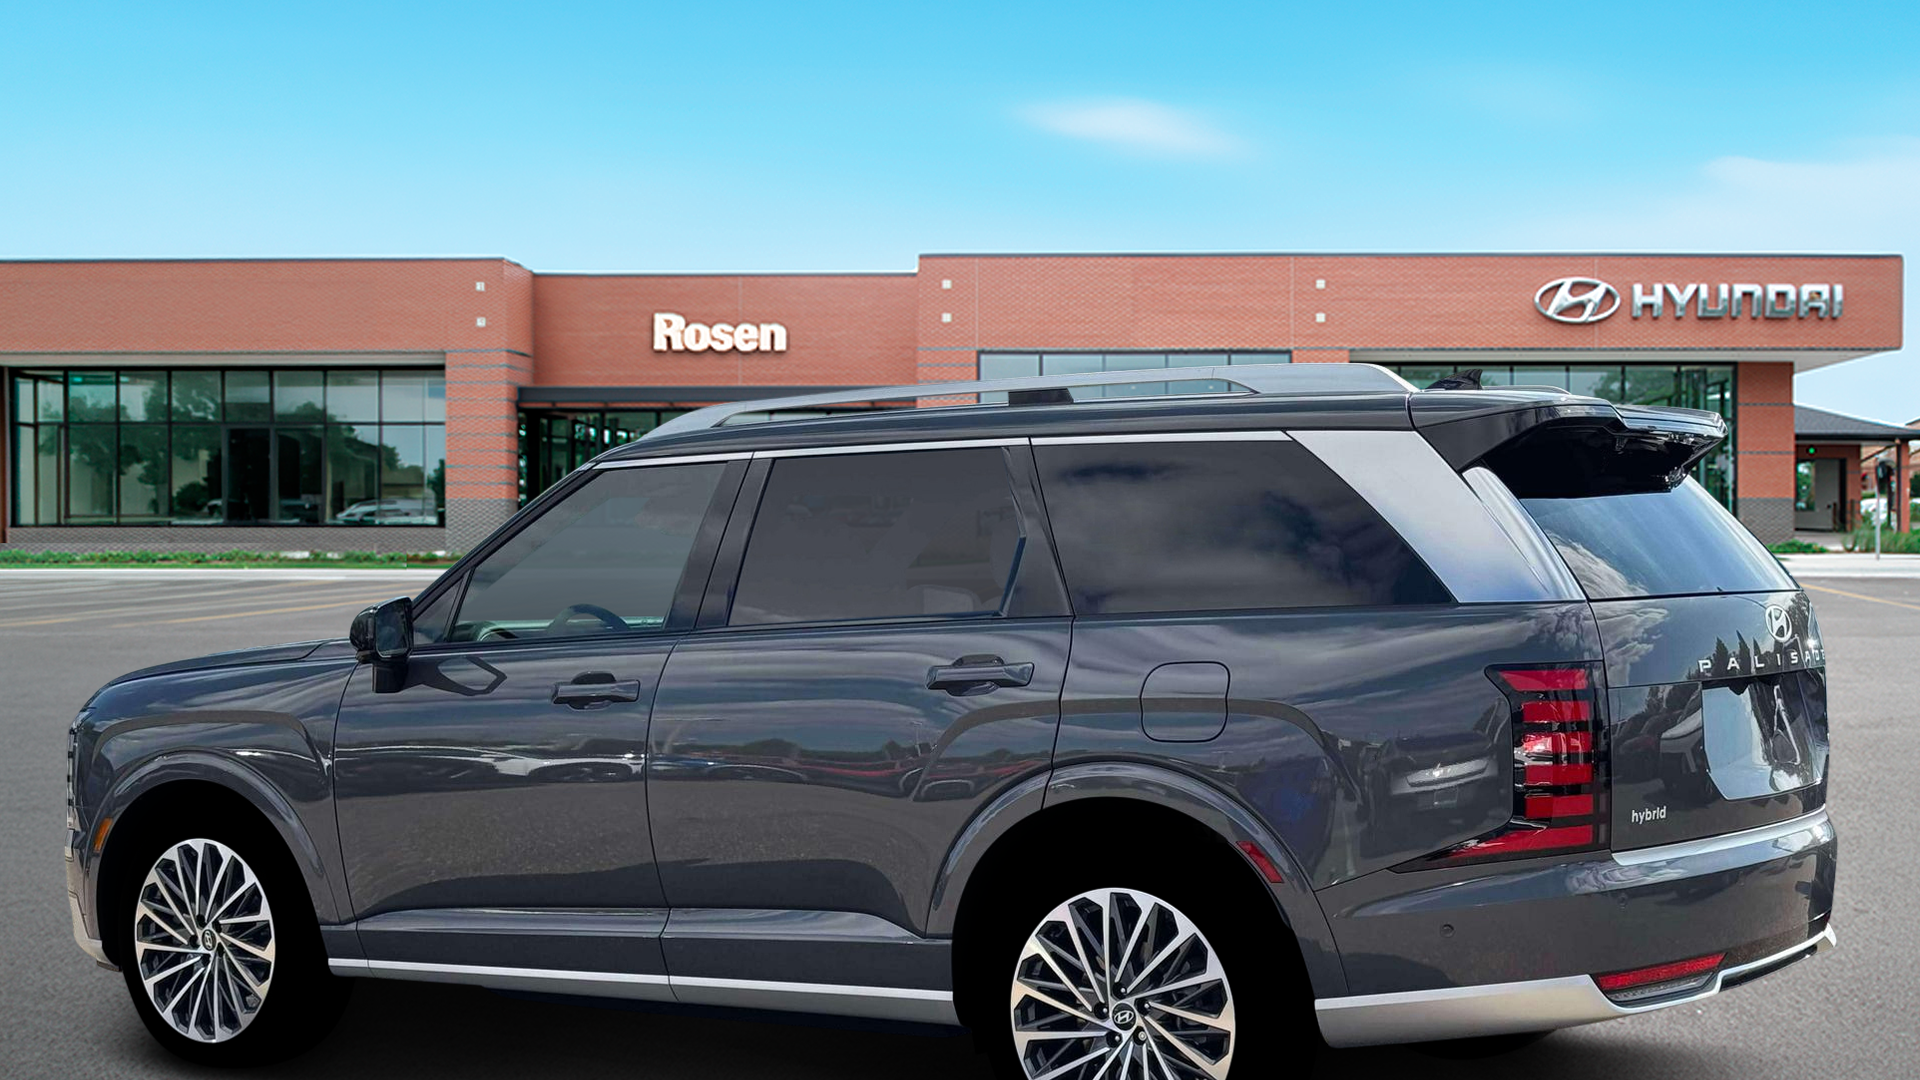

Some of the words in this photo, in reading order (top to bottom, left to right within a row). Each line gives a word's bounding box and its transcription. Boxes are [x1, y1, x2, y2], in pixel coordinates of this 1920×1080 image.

[1631, 283, 1844, 318] HYUNDAI
[653, 312, 787, 351] Rosen
[1631, 805, 1667, 825] hybrid
